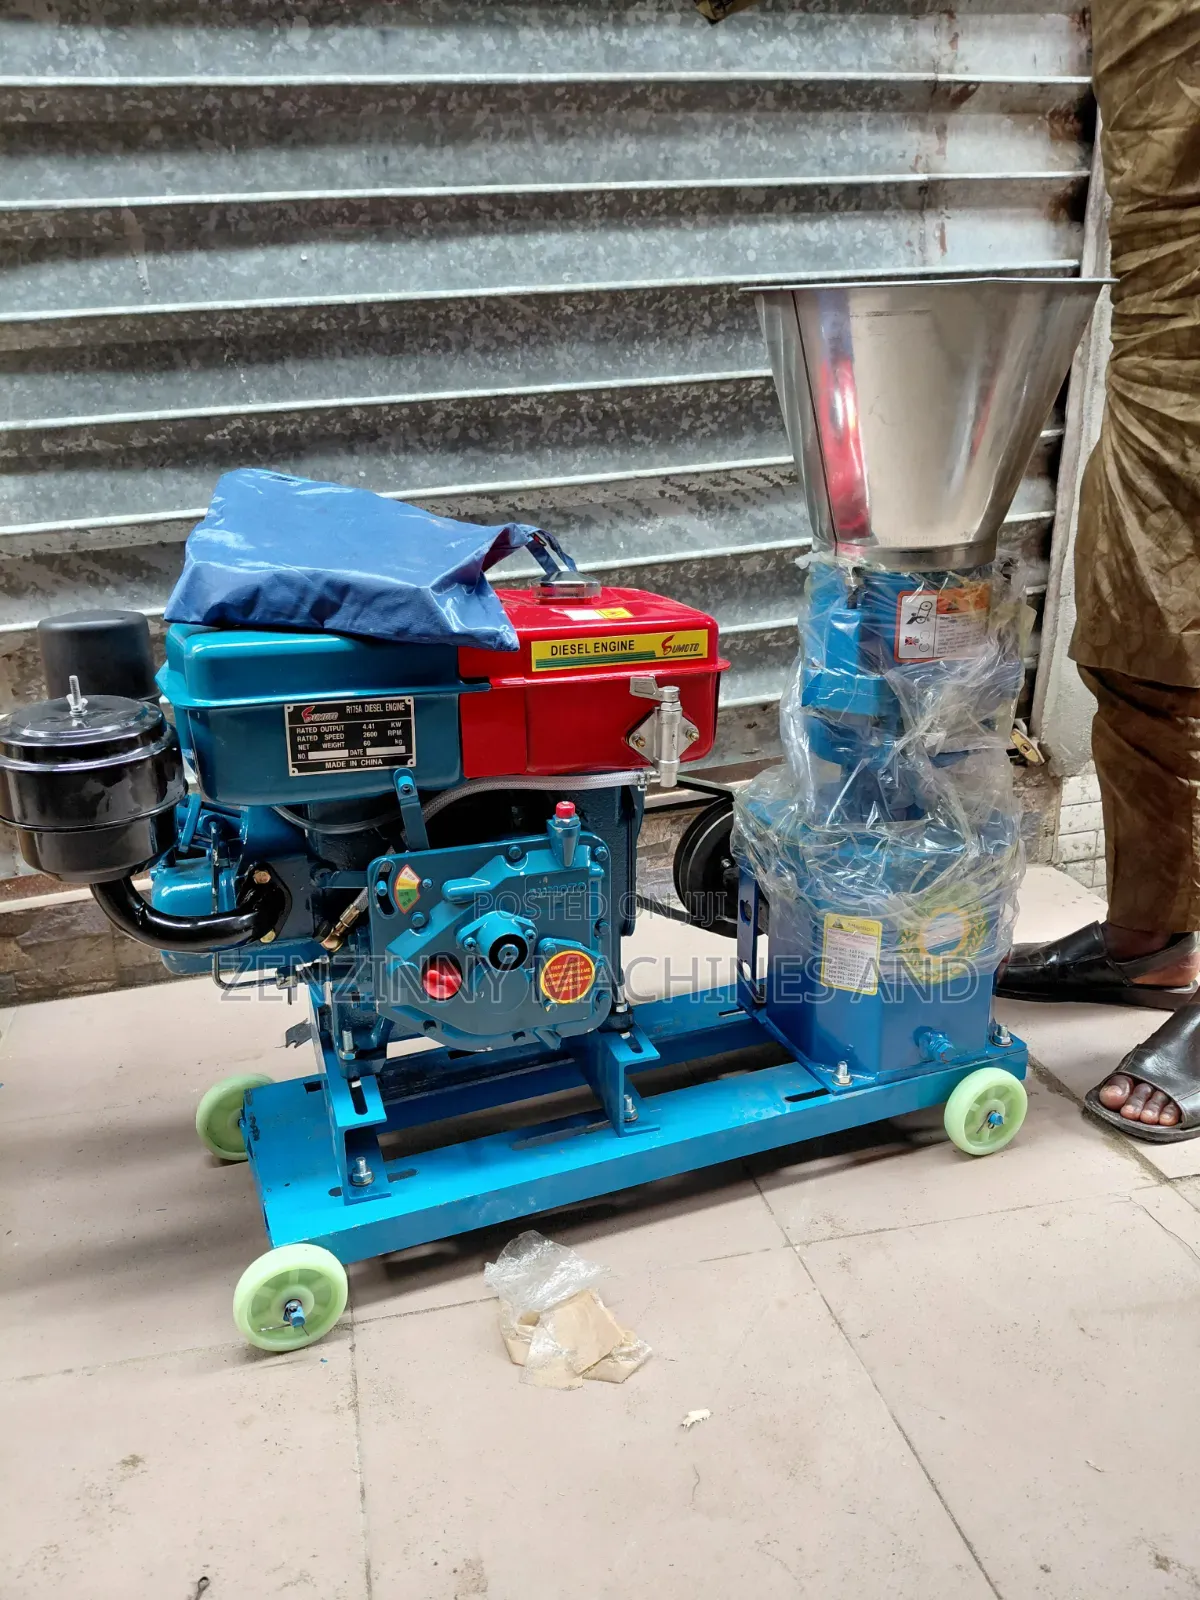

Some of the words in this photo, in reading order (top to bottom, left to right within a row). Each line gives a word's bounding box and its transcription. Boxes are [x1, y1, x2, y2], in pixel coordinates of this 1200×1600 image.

[551, 644, 590, 656] DIESEL
[594, 640, 634, 653] ENGINE
[346, 705, 362, 714] R175A
[365, 703, 383, 712] DIESEL
[385, 702, 405, 711] ENGINE
[296, 726, 318, 734] RATED
[320, 725, 345, 733] OUTPUT
[324, 733, 345, 741] SPEED
[322, 741, 346, 749] WEIGHT
[325, 761, 346, 769] MADE
